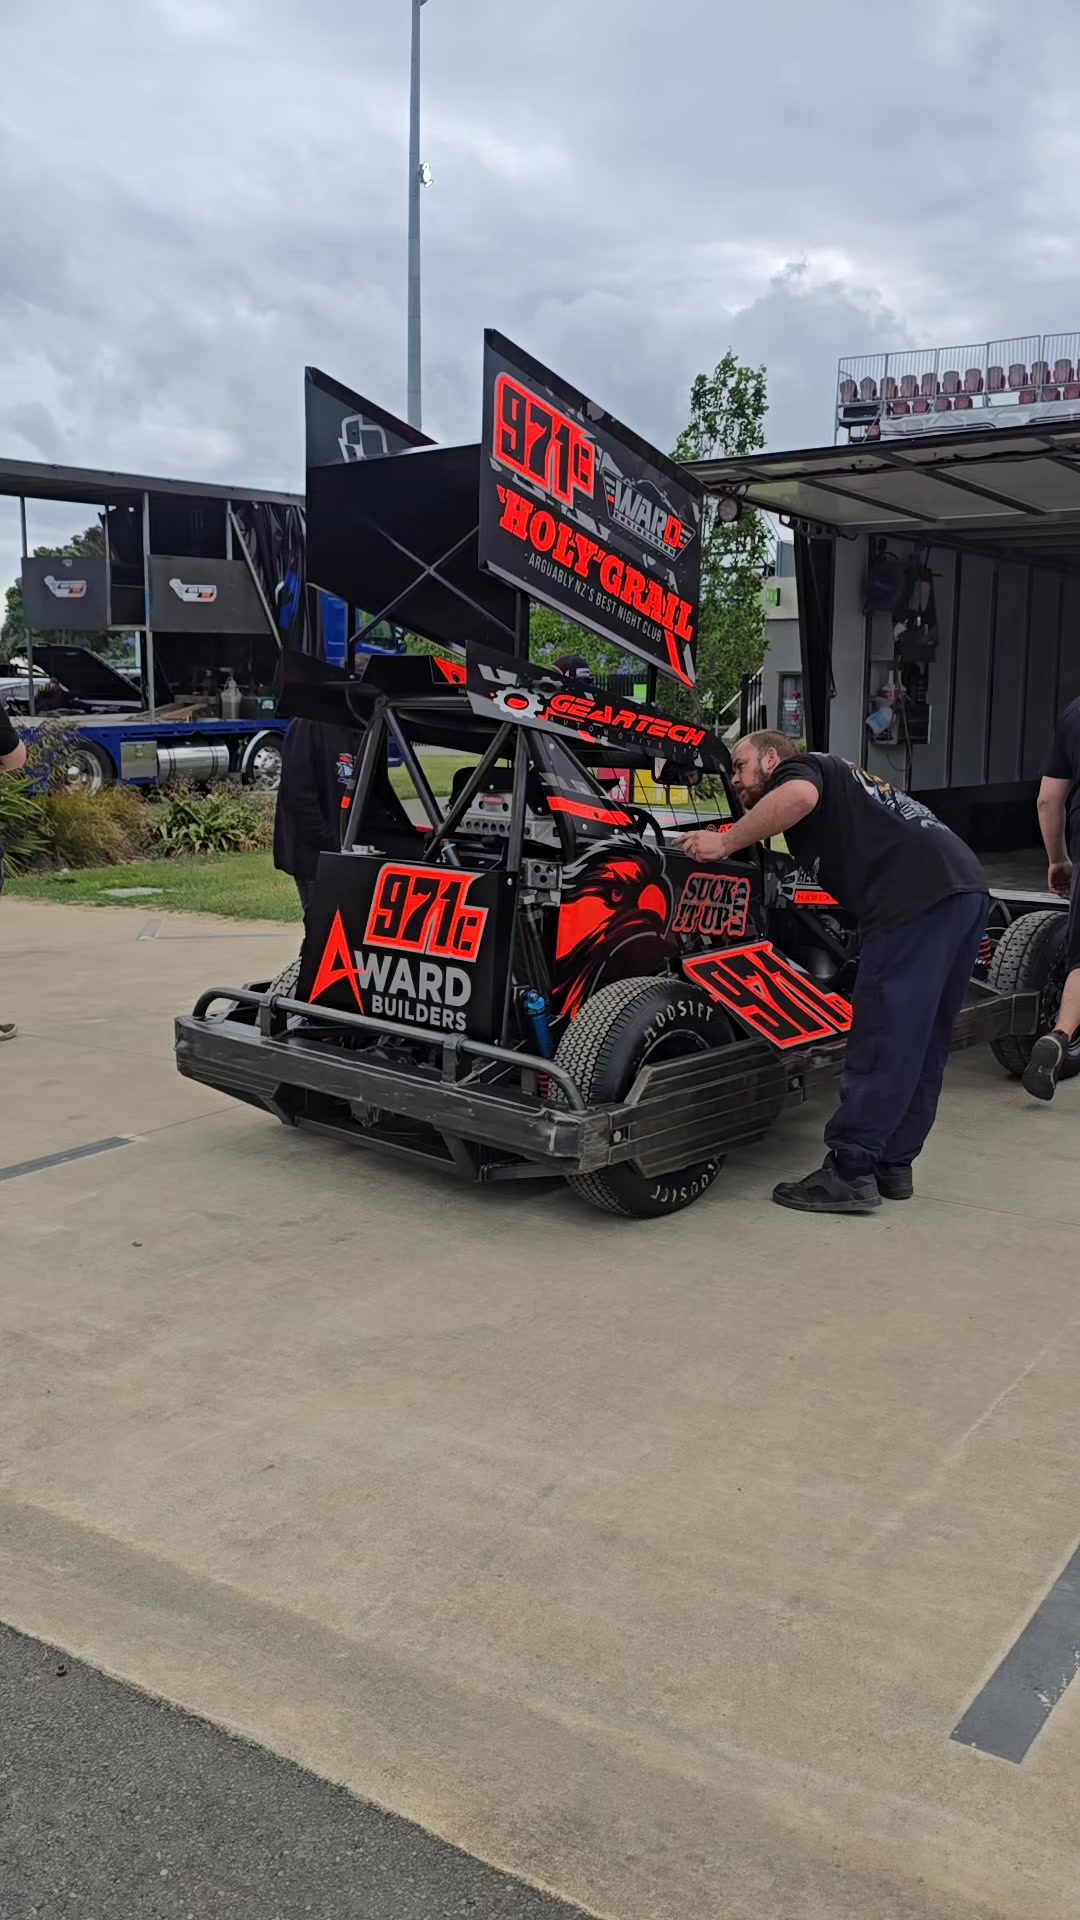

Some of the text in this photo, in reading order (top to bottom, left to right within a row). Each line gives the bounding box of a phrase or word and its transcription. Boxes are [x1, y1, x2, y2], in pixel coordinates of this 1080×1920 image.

[614, 480, 683, 547] WARD
[498, 487, 693, 642] HOLY GRAIL
[528, 552, 662, 643] ARGUABLY NZ'S BEST NIGHT CLUB
[549, 716, 663, 749] AUTOMOTIVE
[550, 694, 707, 746] GEARTECH
[684, 877, 736, 904] SUCK
[677, 903, 731, 931] IT UP
[372, 995, 467, 1031] BUILDERS
